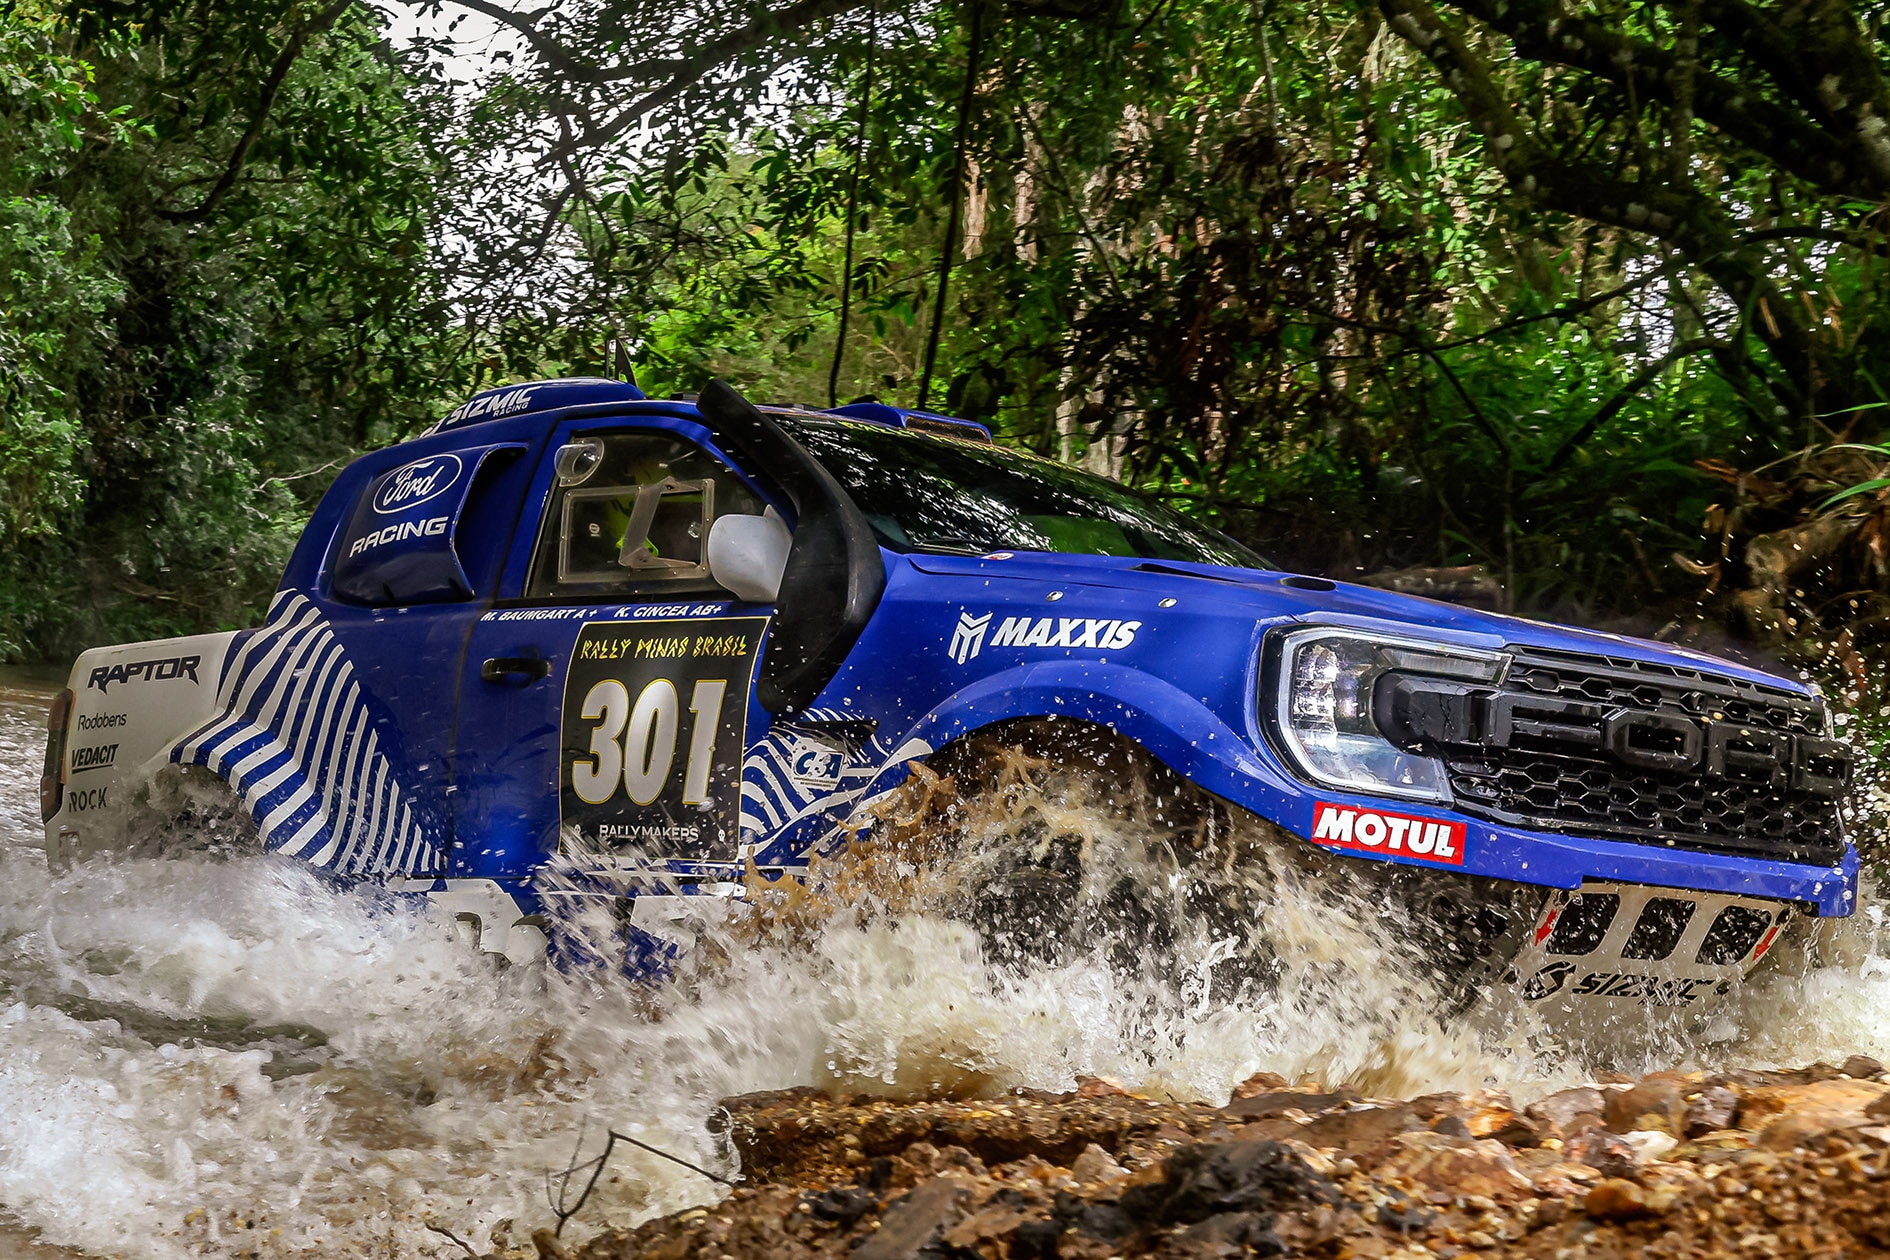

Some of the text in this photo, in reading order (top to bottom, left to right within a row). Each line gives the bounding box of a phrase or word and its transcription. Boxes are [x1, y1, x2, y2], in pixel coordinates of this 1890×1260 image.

[446, 386, 542, 425] SIZMIC
[493, 402, 529, 417] RACING
[382, 460, 444, 506] Ford
[349, 516, 449, 558] RACING
[480, 612, 496, 622] M.
[498, 609, 574, 622] BAUMGART
[613, 604, 723, 618] K. CINCEA AB+
[580, 634, 748, 659] RALLY MINAS BRASIL
[990, 616, 1142, 650] MAXXIS
[87, 655, 201, 695] RAPTOR
[78, 712, 127, 731] Rodobens
[72, 743, 119, 768] VEDACIT
[572, 678, 727, 806] 301
[69, 786, 108, 813] ROCK
[1315, 806, 1456, 858] MOTUL
